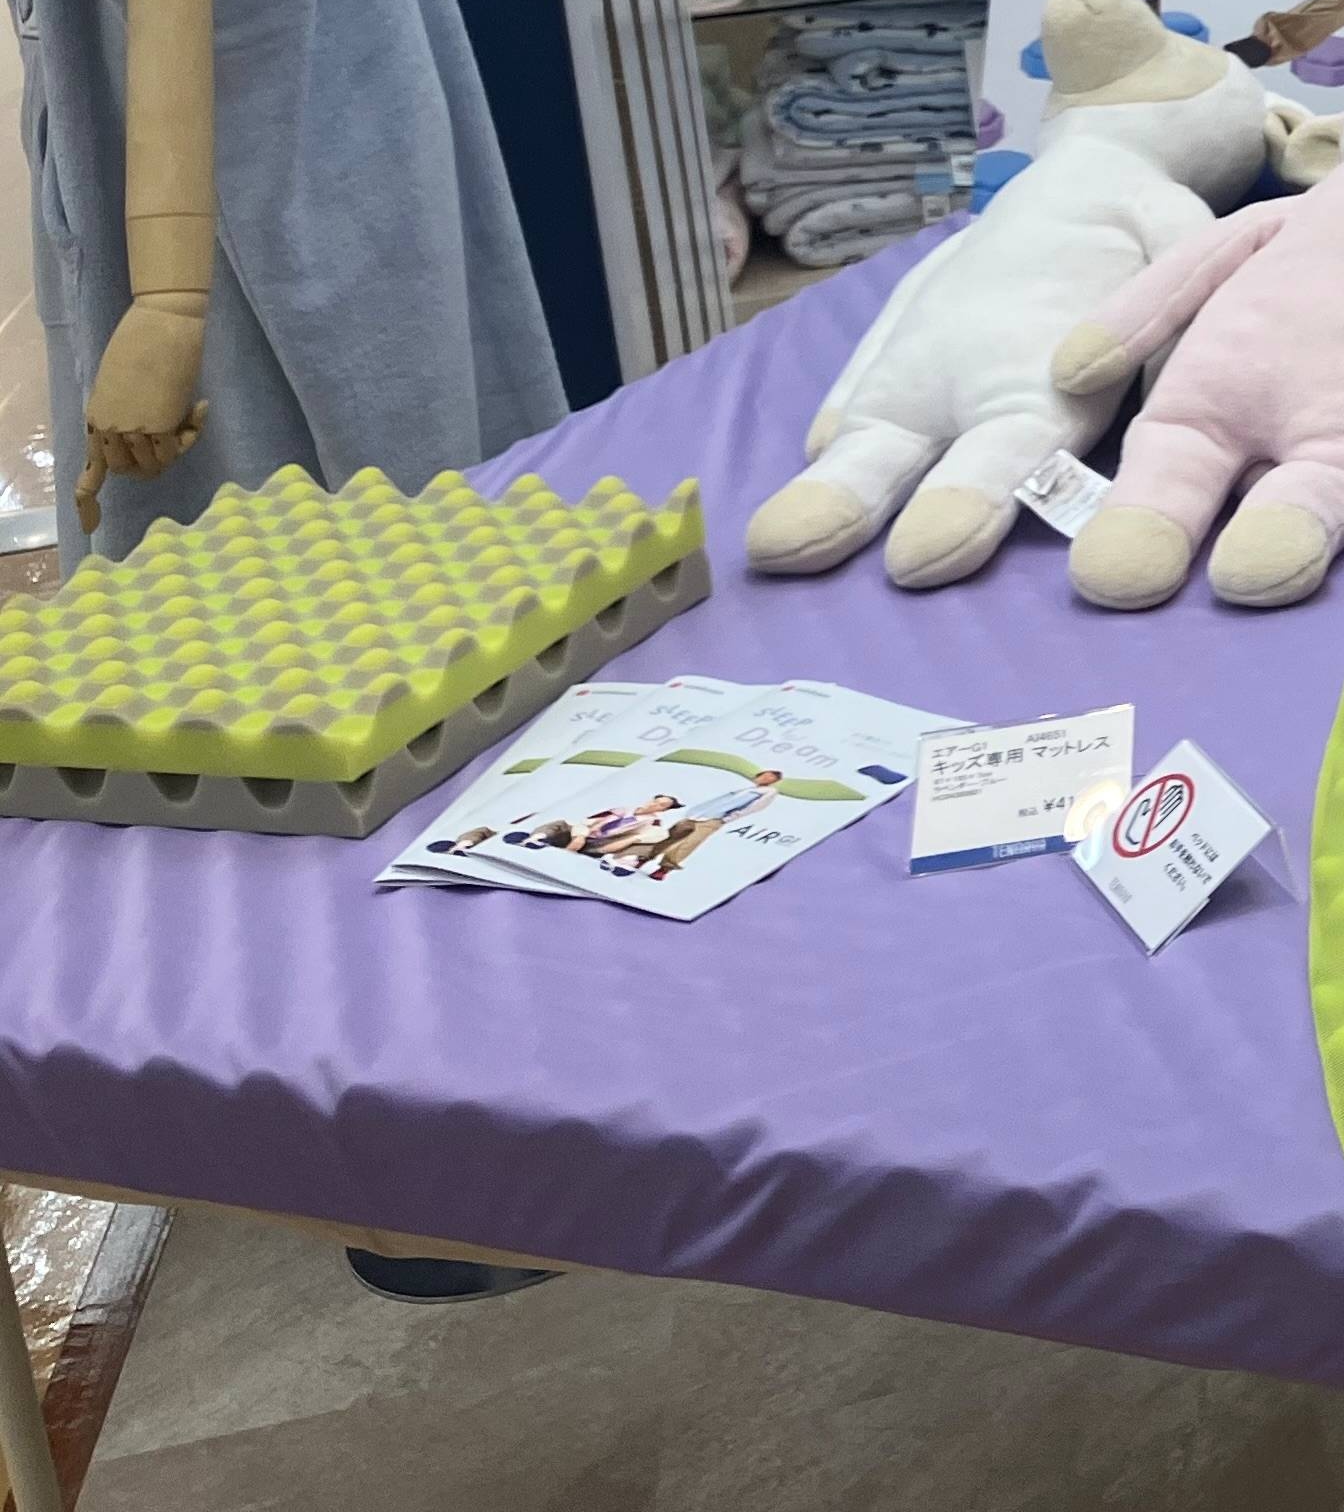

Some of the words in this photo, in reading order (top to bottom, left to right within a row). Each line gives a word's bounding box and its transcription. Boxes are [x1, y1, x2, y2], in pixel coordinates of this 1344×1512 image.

[931, 747, 1024, 776] キッズ専用
[1031, 735, 1111, 758] マットレス
